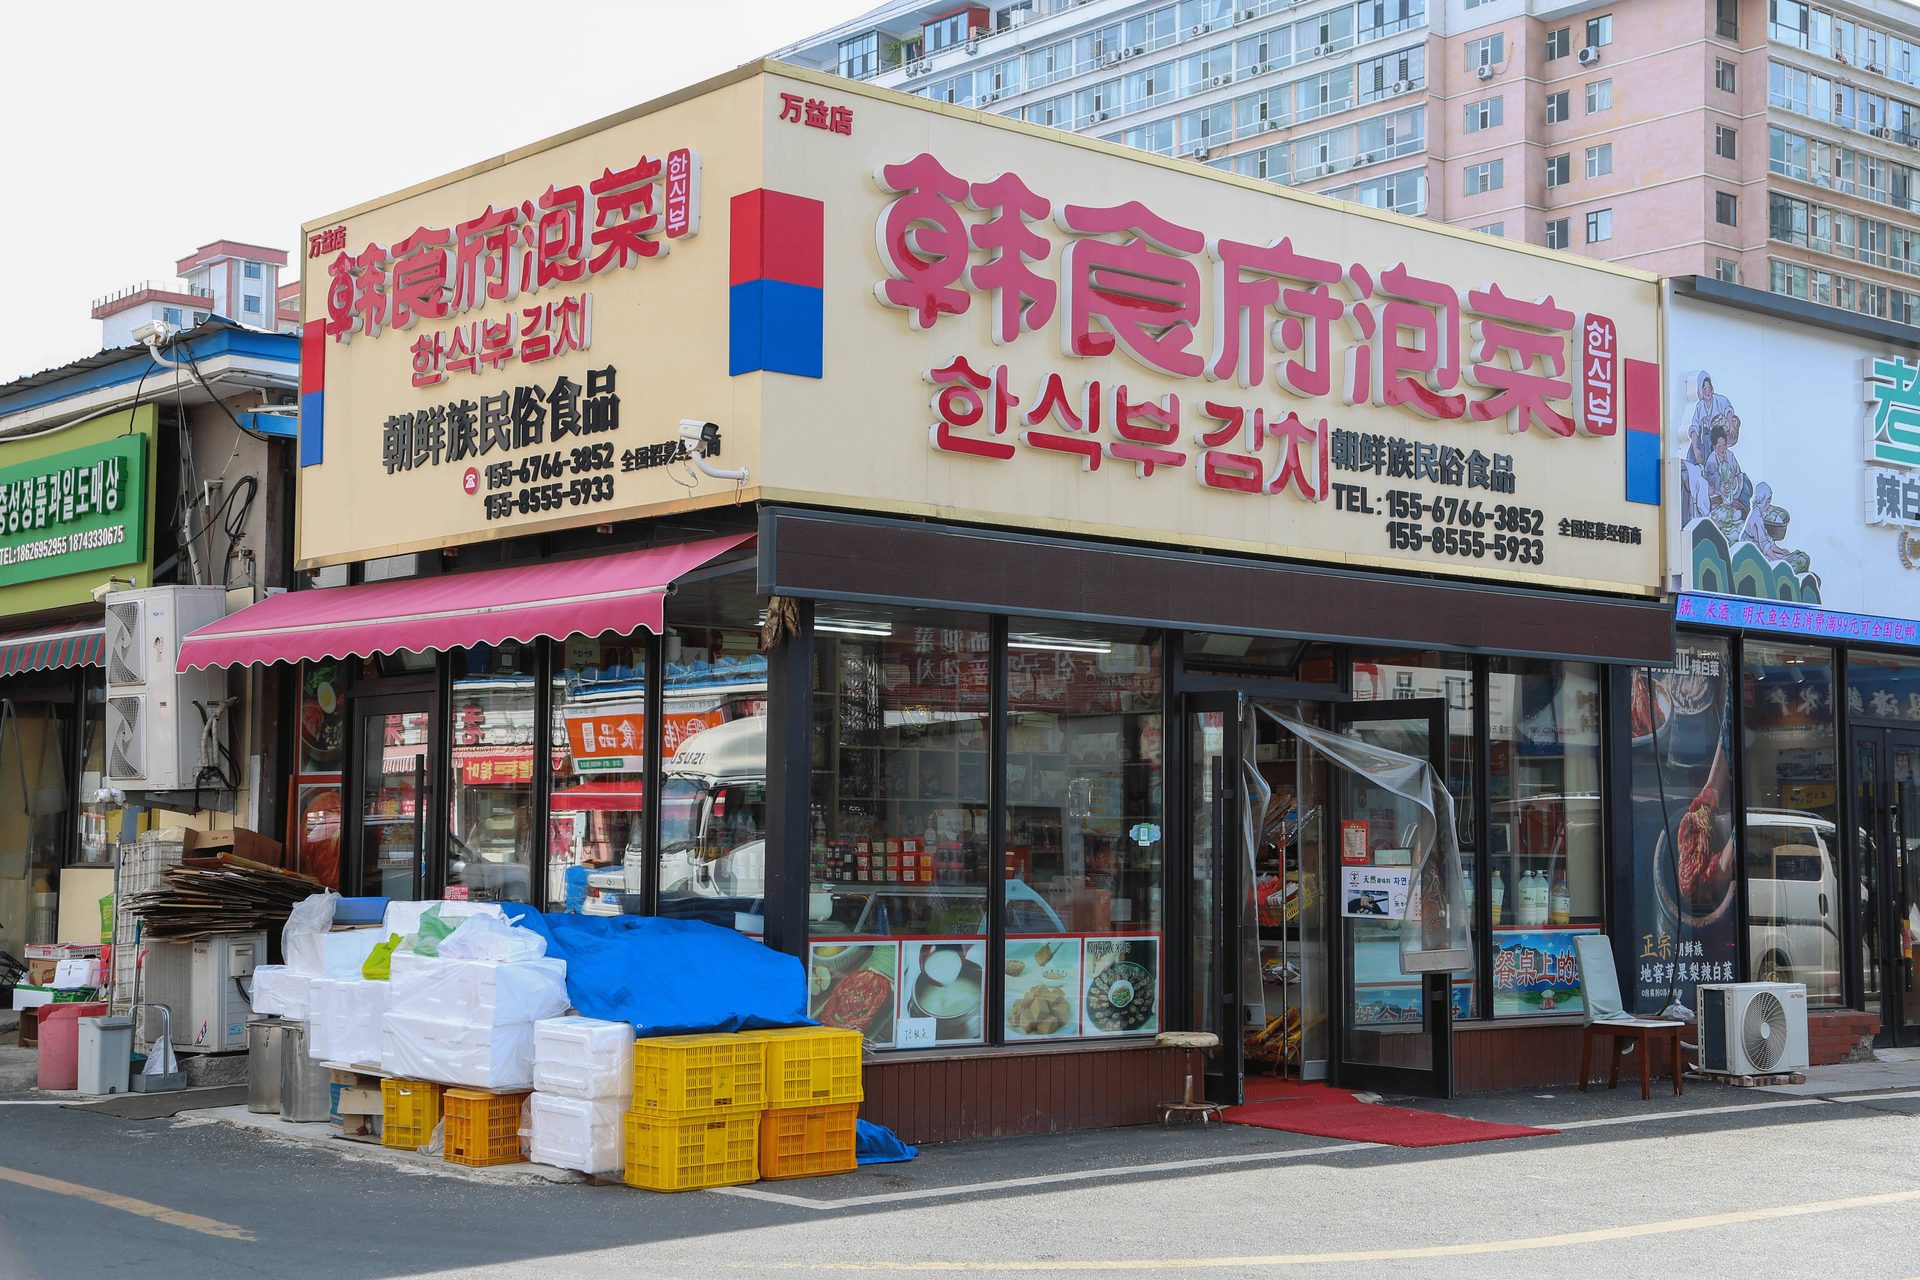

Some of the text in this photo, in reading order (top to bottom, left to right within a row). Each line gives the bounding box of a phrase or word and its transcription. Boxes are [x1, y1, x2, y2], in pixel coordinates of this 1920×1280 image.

[779, 93, 854, 136] 万益店
[668, 152, 688, 233] 한식부
[308, 226, 347, 259] 万益店
[326, 155, 666, 343] 韩食府泡菜
[878, 152, 1577, 439] 韩食府泡菜
[1587, 320, 1613, 428] 한식부
[382, 364, 620, 475] 朝鲜族民俗食品
[484, 442, 614, 490] 155-6766-3852
[1332, 428, 1516, 494] 朝鲜族民俗食品
[484, 474, 614, 520] 155-8555-5933
[1385, 521, 1544, 565] 155-8555-5933
[1557, 517, 1643, 545] 全国招募经销商
[1639, 933, 1672, 961] 正宗
